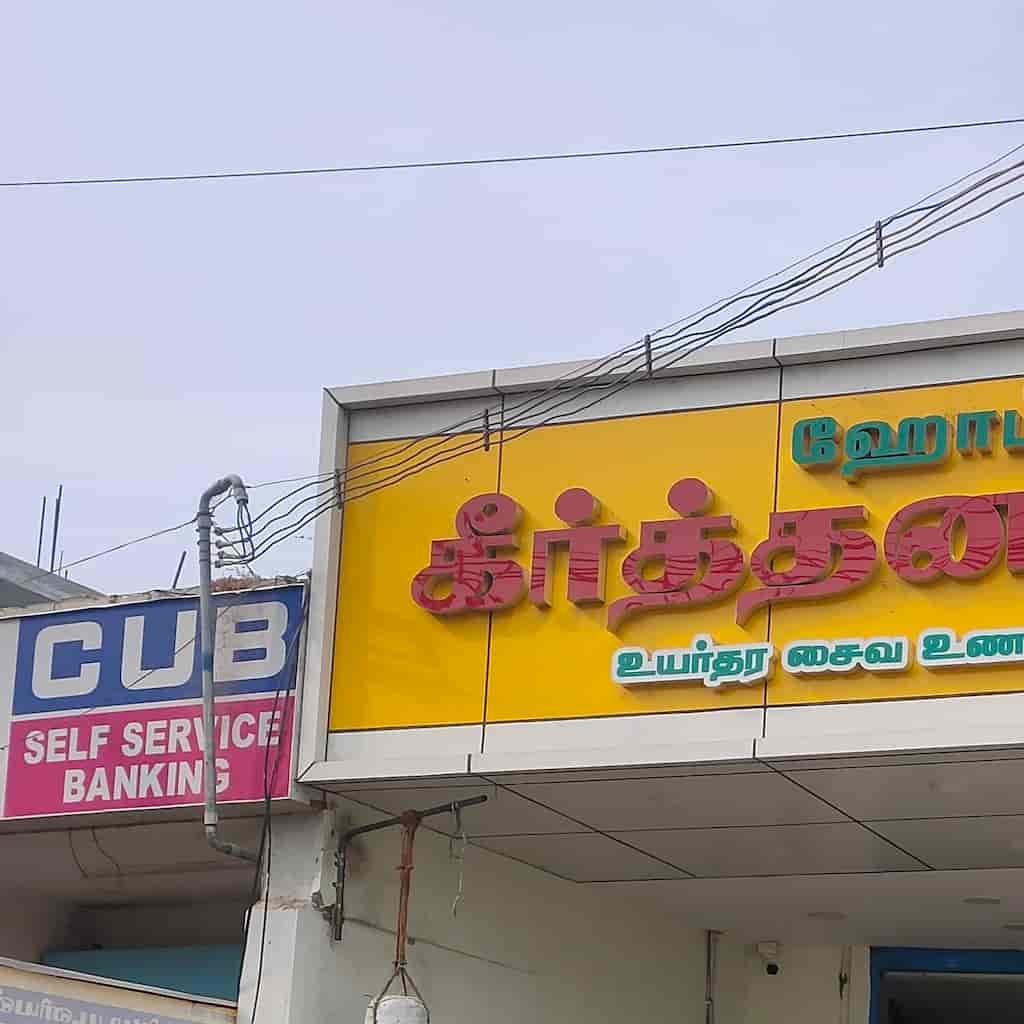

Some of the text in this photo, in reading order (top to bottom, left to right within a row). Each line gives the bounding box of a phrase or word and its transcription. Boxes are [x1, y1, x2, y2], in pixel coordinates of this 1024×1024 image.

[31, 600, 289, 699] CUB
[615, 640, 769, 683] உயர்தர
[786, 640, 904, 668] சைவ
[23, 711, 281, 765] SELF SERVICE
[63, 759, 230, 804] BANKING
